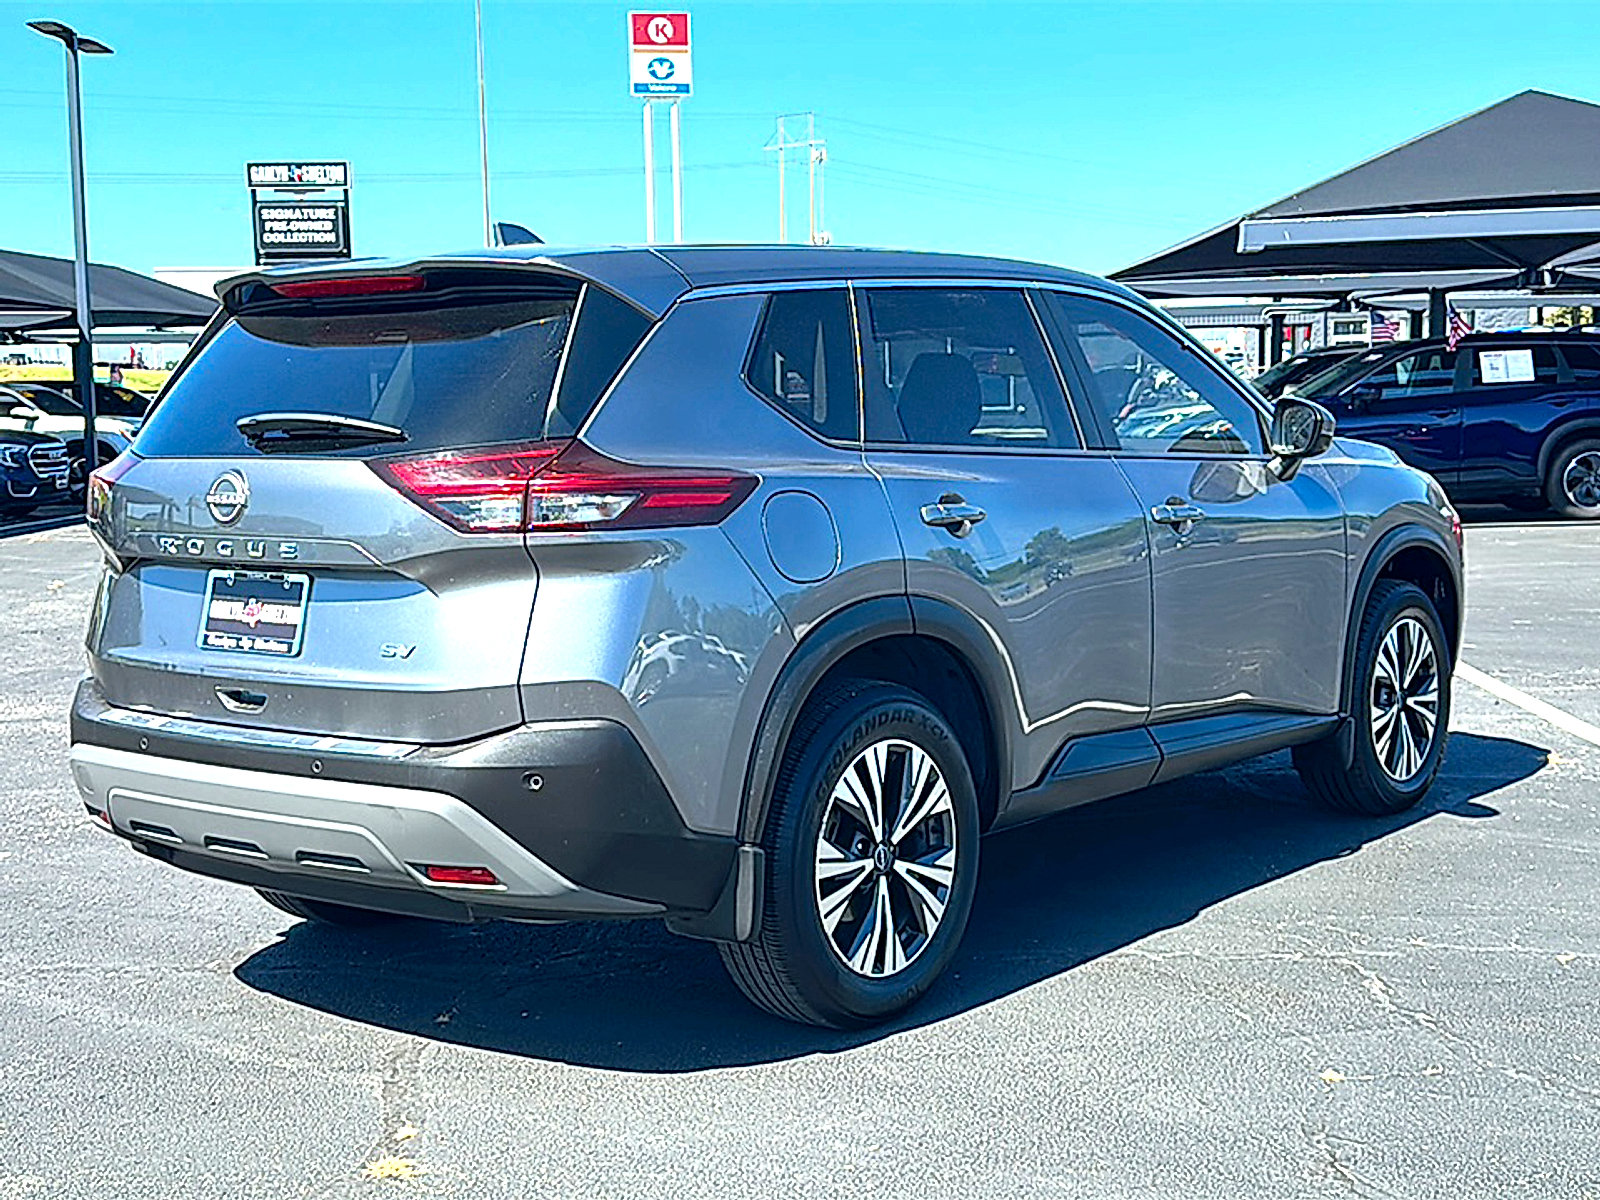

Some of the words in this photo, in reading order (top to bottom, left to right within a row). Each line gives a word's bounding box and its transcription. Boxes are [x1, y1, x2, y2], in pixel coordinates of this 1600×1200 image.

[260, 208, 336, 220] SIGNATURE
[264, 220, 333, 232] PRE-OWNED
[262, 231, 337, 243] COLLECTION
[159, 537, 299, 559] ROGUE
[379, 642, 417, 660] SV
